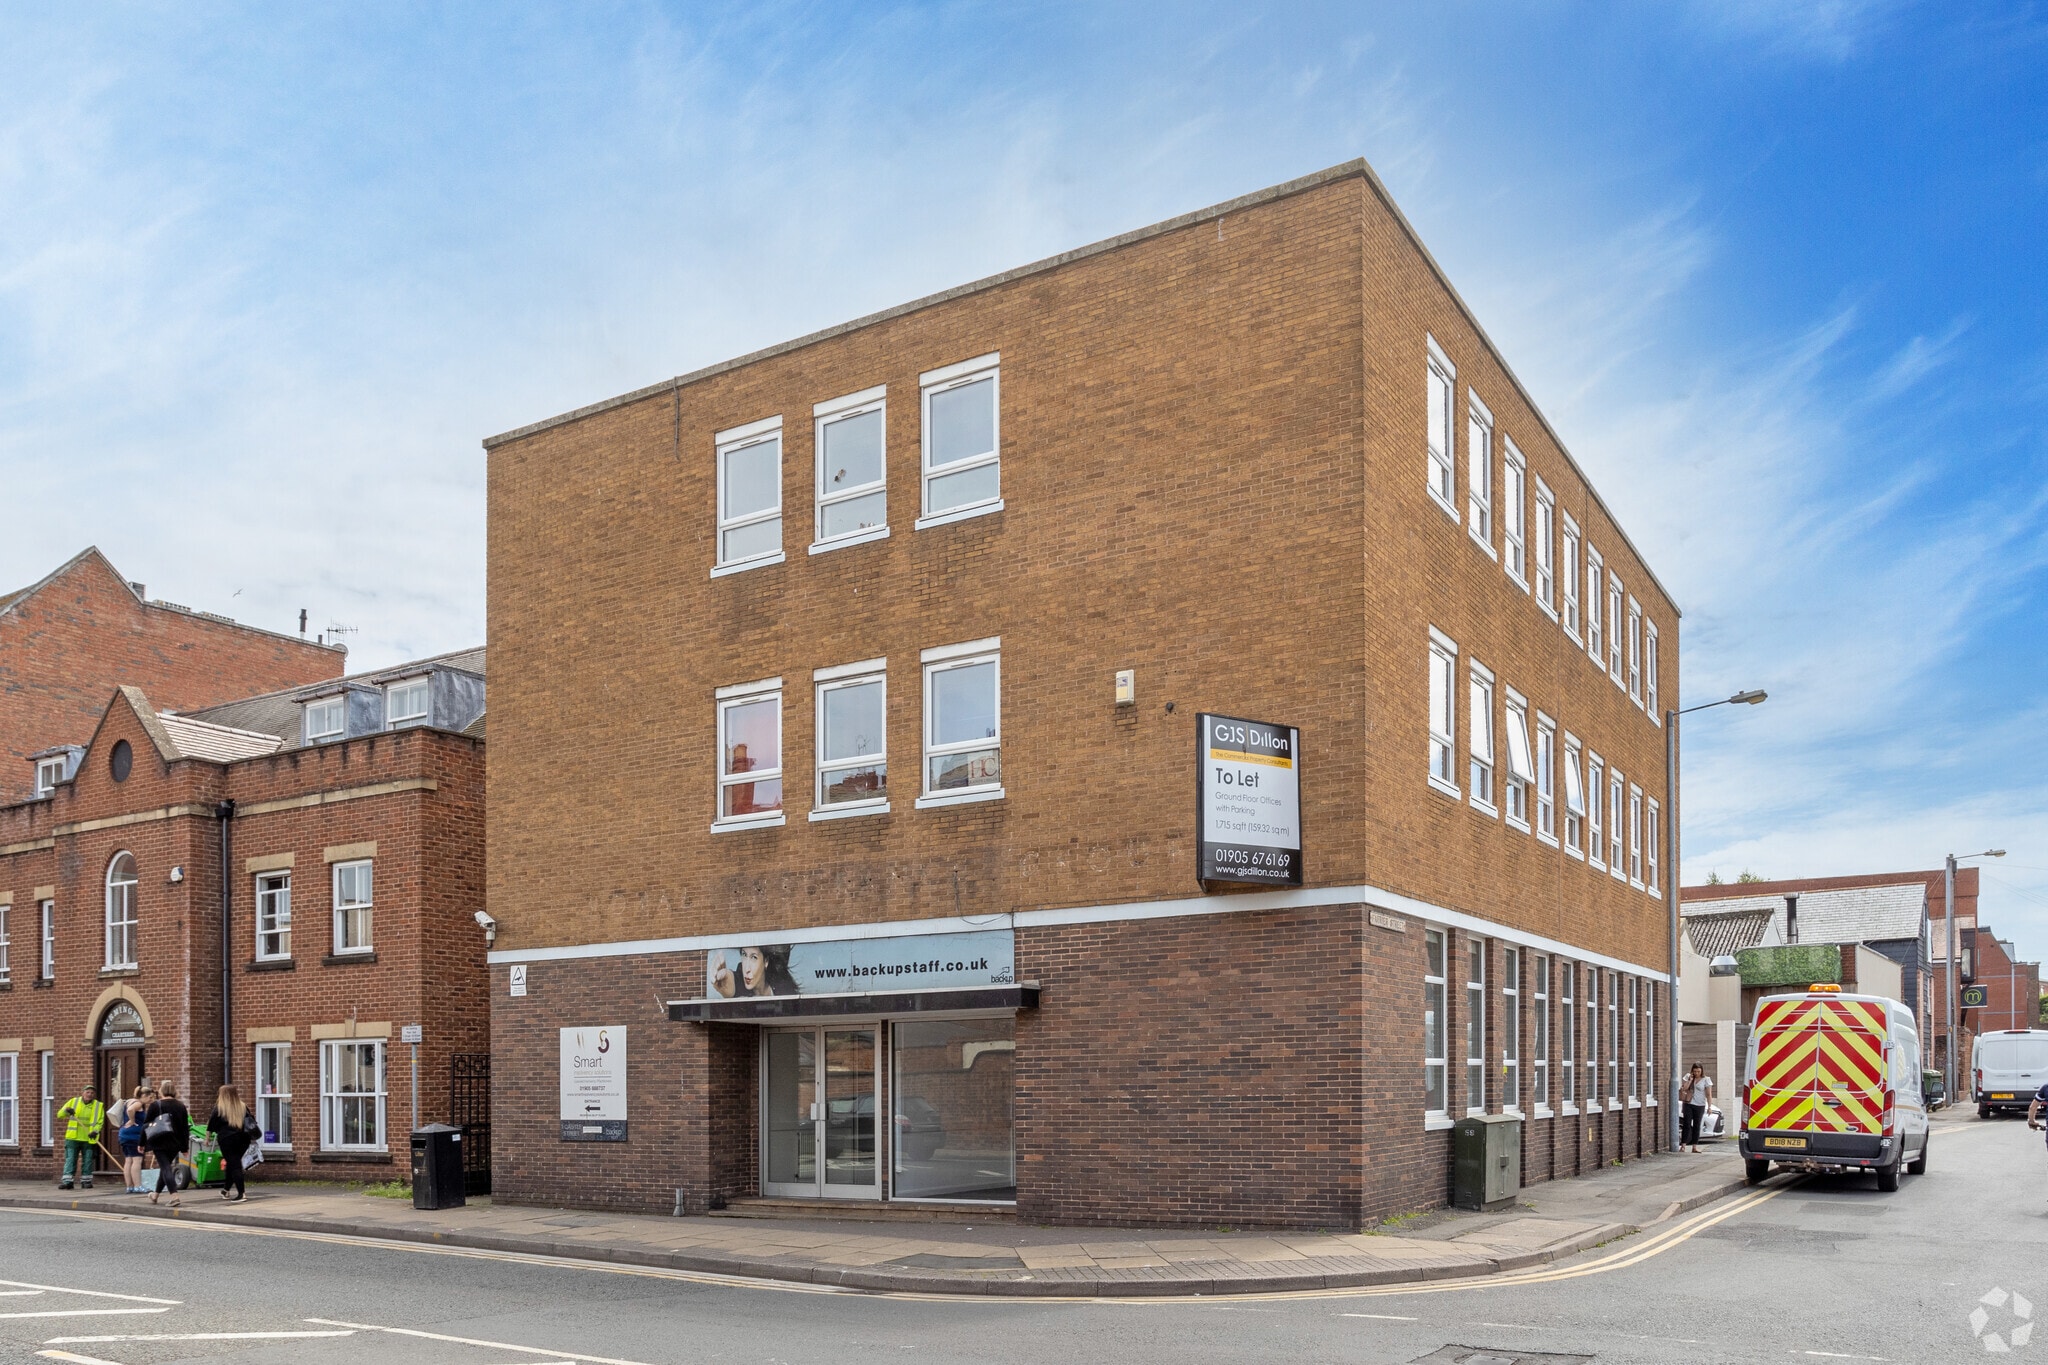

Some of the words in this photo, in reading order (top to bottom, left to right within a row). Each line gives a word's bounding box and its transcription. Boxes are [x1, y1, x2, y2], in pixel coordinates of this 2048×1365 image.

[1215, 724, 1245, 744] GJS
[1249, 729, 1288, 750] Dillon
[1224, 752, 1249, 760] Commercial
[1216, 767, 1233, 784] To
[1238, 769, 1259, 788] Let
[1215, 791, 1242, 801] Ground
[1243, 794, 1258, 803] Floor
[1260, 796, 1282, 806] Offices
[1216, 804, 1230, 812] with
[1231, 805, 1255, 816] Parking
[1215, 848, 1248, 864] 01905
[1251, 852, 1290, 867] 676169
[1215, 866, 1290, 878] www.gjsdillon.co.uk
[815, 957, 988, 978] www.backupstaff.co.uk
[573, 1055, 602, 1068] Smart
